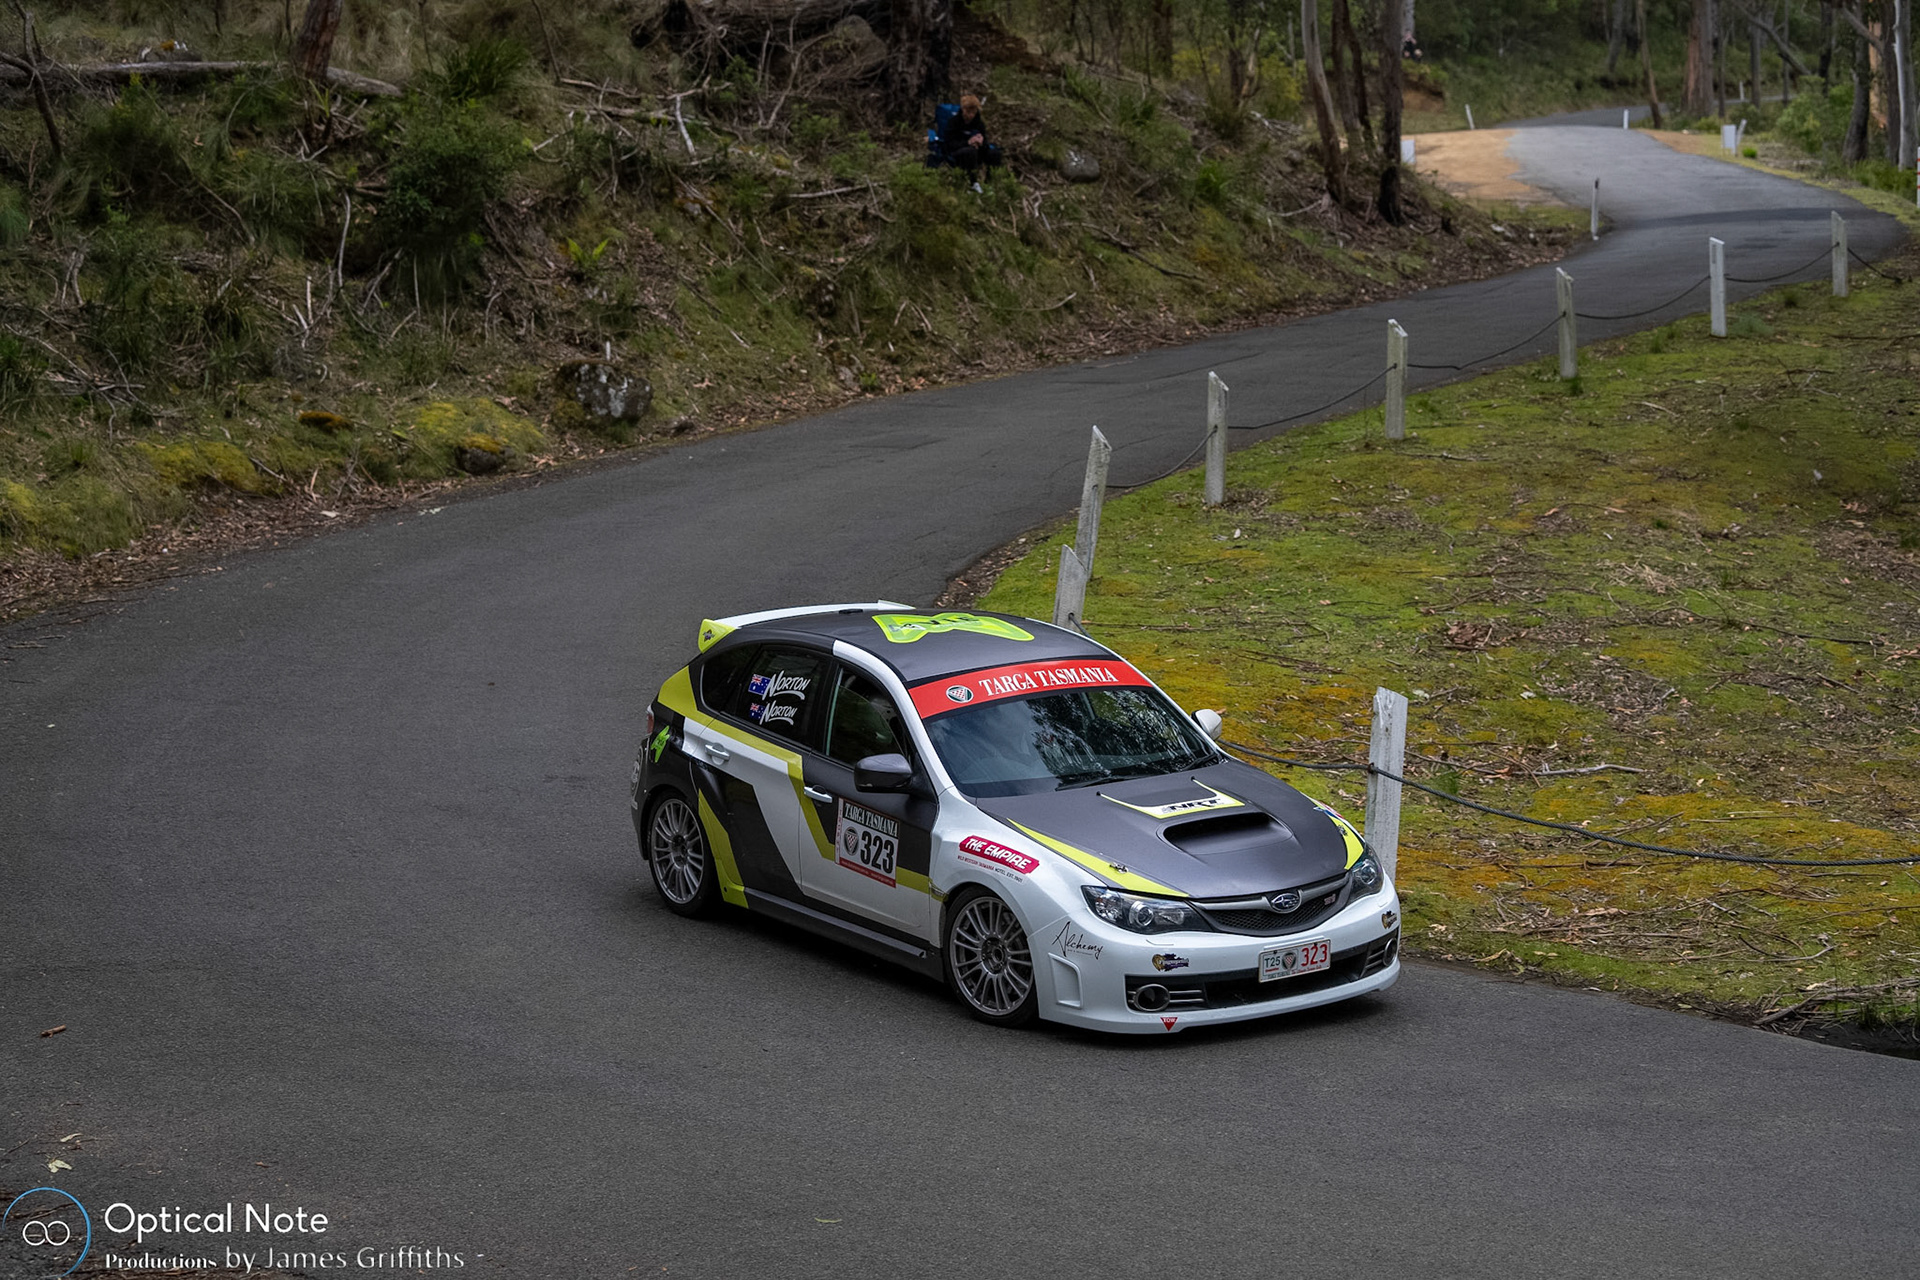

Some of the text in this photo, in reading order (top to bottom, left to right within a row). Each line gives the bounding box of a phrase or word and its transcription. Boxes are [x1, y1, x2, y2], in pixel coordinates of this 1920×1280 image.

[979, 667, 1119, 697] TARGA TASMANIA
[844, 803, 866, 823] TARGA
[866, 811, 899, 837] TASMANIA
[860, 831, 895, 874] 323
[965, 838, 1032, 870] THE EMPIRE
[1051, 921, 1103, 960] Alchemy
[1264, 944, 1328, 968] T25 323
